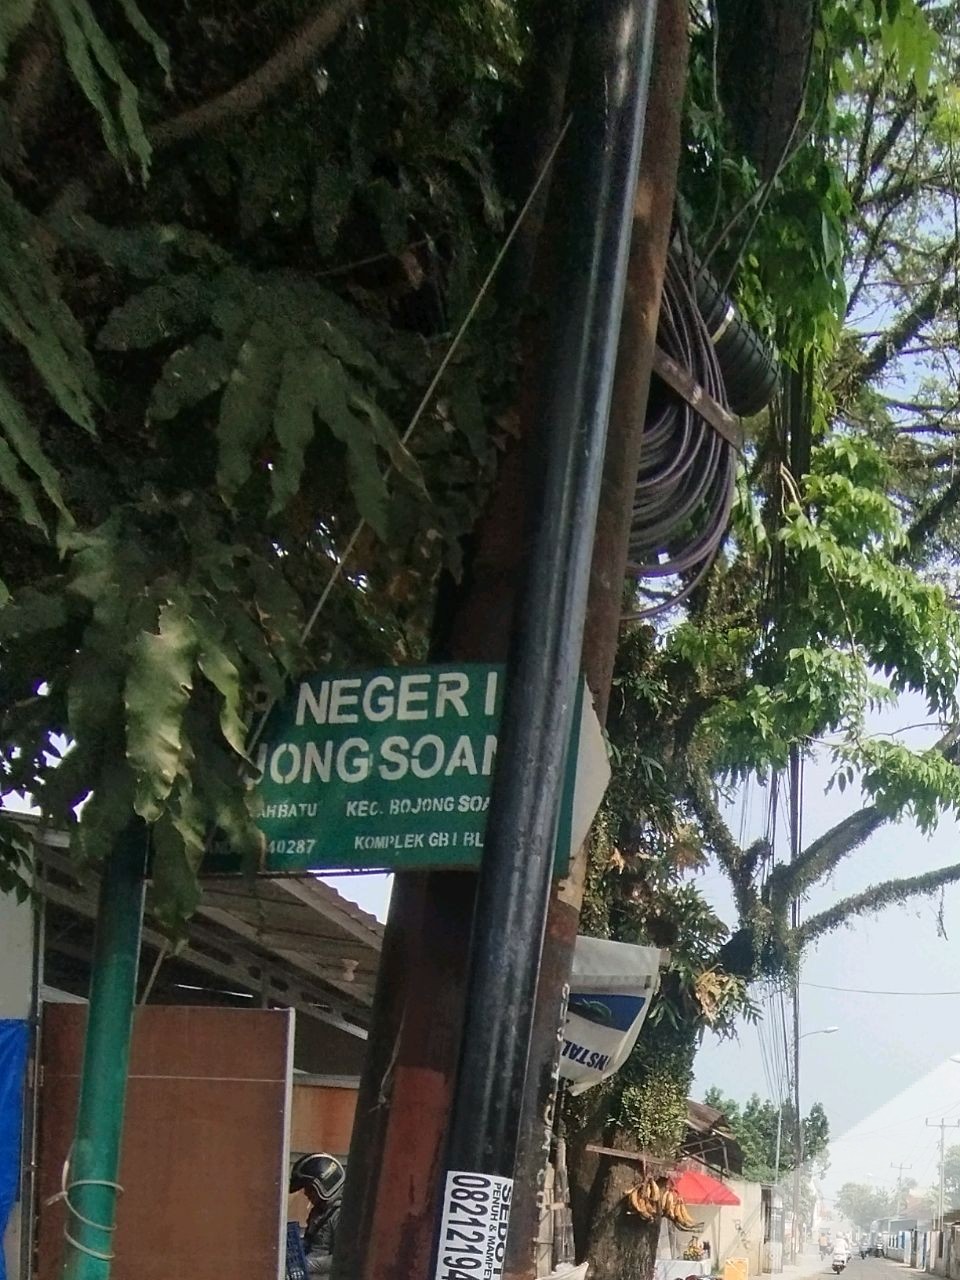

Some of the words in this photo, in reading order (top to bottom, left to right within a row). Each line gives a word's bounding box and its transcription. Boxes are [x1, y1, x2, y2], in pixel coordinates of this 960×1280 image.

[345, 800, 384, 817] KEC.
[268, 839, 317, 855] 40287
[354, 833, 424, 850] KOMPLEK
[490, 1182, 502, 1222] PENUH
[488, 1223, 498, 1233] &
